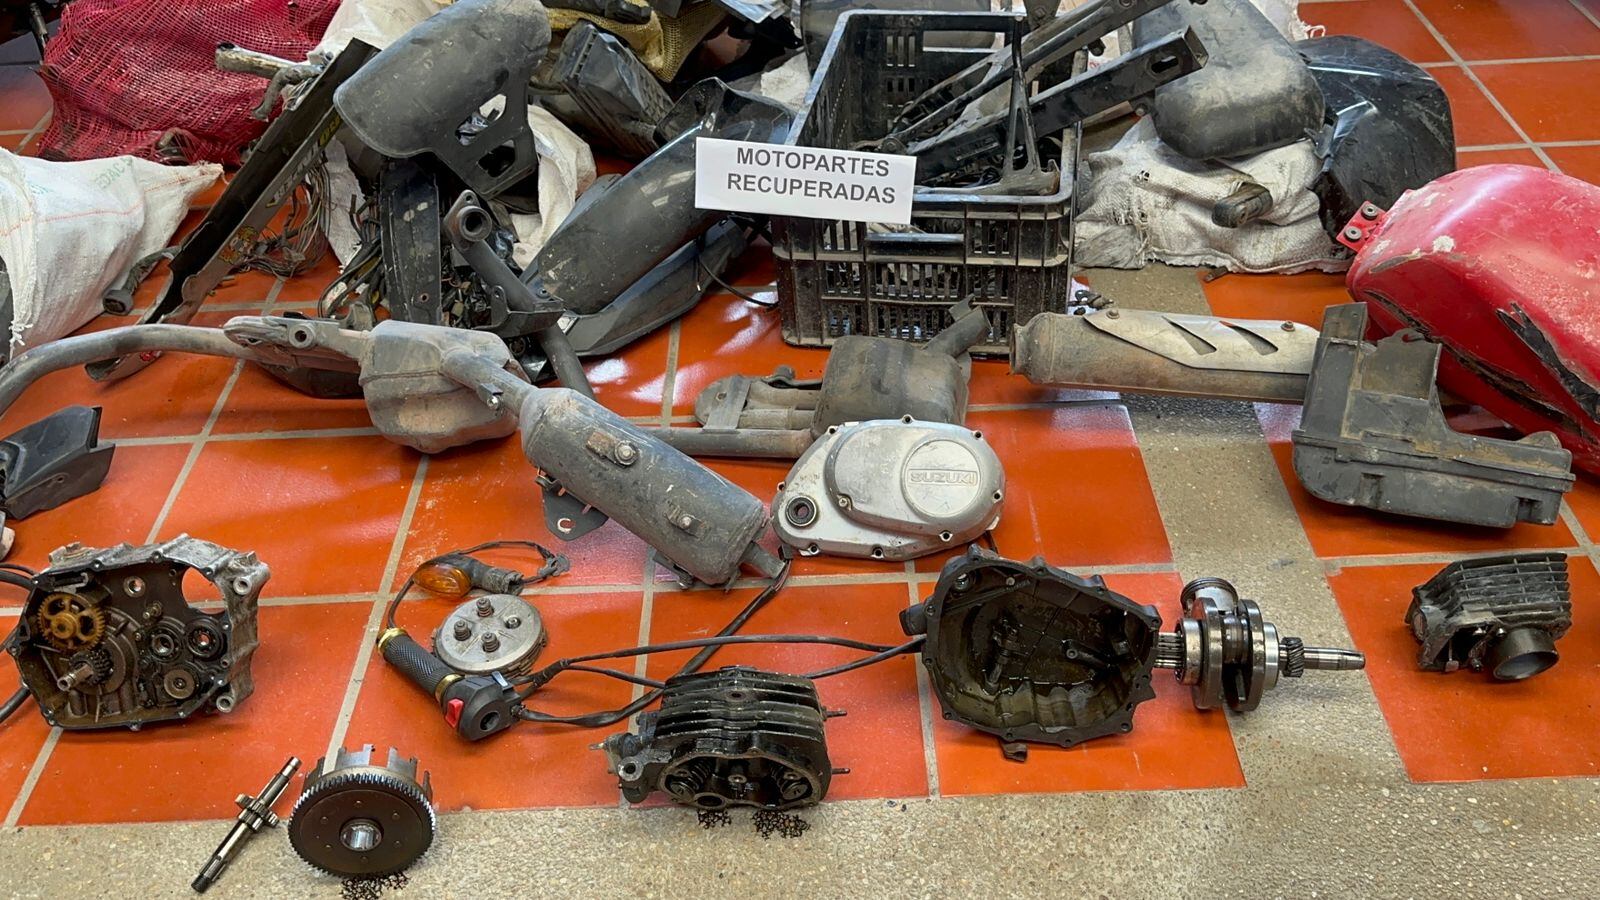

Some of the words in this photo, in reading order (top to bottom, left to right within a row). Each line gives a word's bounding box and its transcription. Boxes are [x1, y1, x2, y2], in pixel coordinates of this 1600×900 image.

[736, 147, 890, 177] MOTOPARTES
[727, 172, 896, 204] RECUPERADAS
[910, 471, 977, 485] SUZUKI
